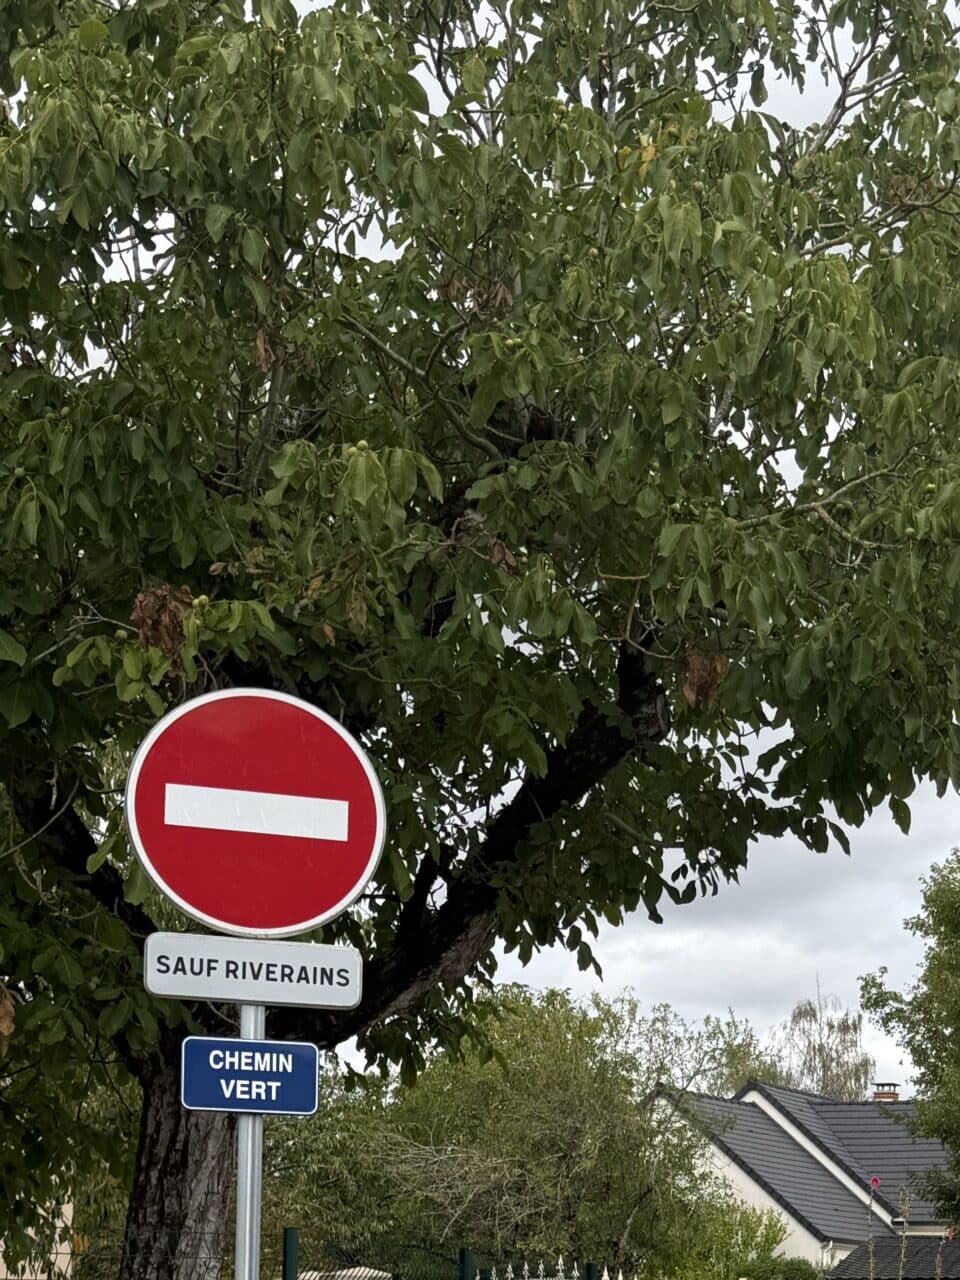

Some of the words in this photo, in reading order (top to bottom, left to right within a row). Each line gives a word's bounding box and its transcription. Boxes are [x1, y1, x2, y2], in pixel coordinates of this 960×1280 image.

[156, 954, 219, 978] SAUF
[225, 960, 350, 987] RIVERAINS
[209, 1049, 293, 1073] CHEMIN
[220, 1079, 282, 1101] VERT
